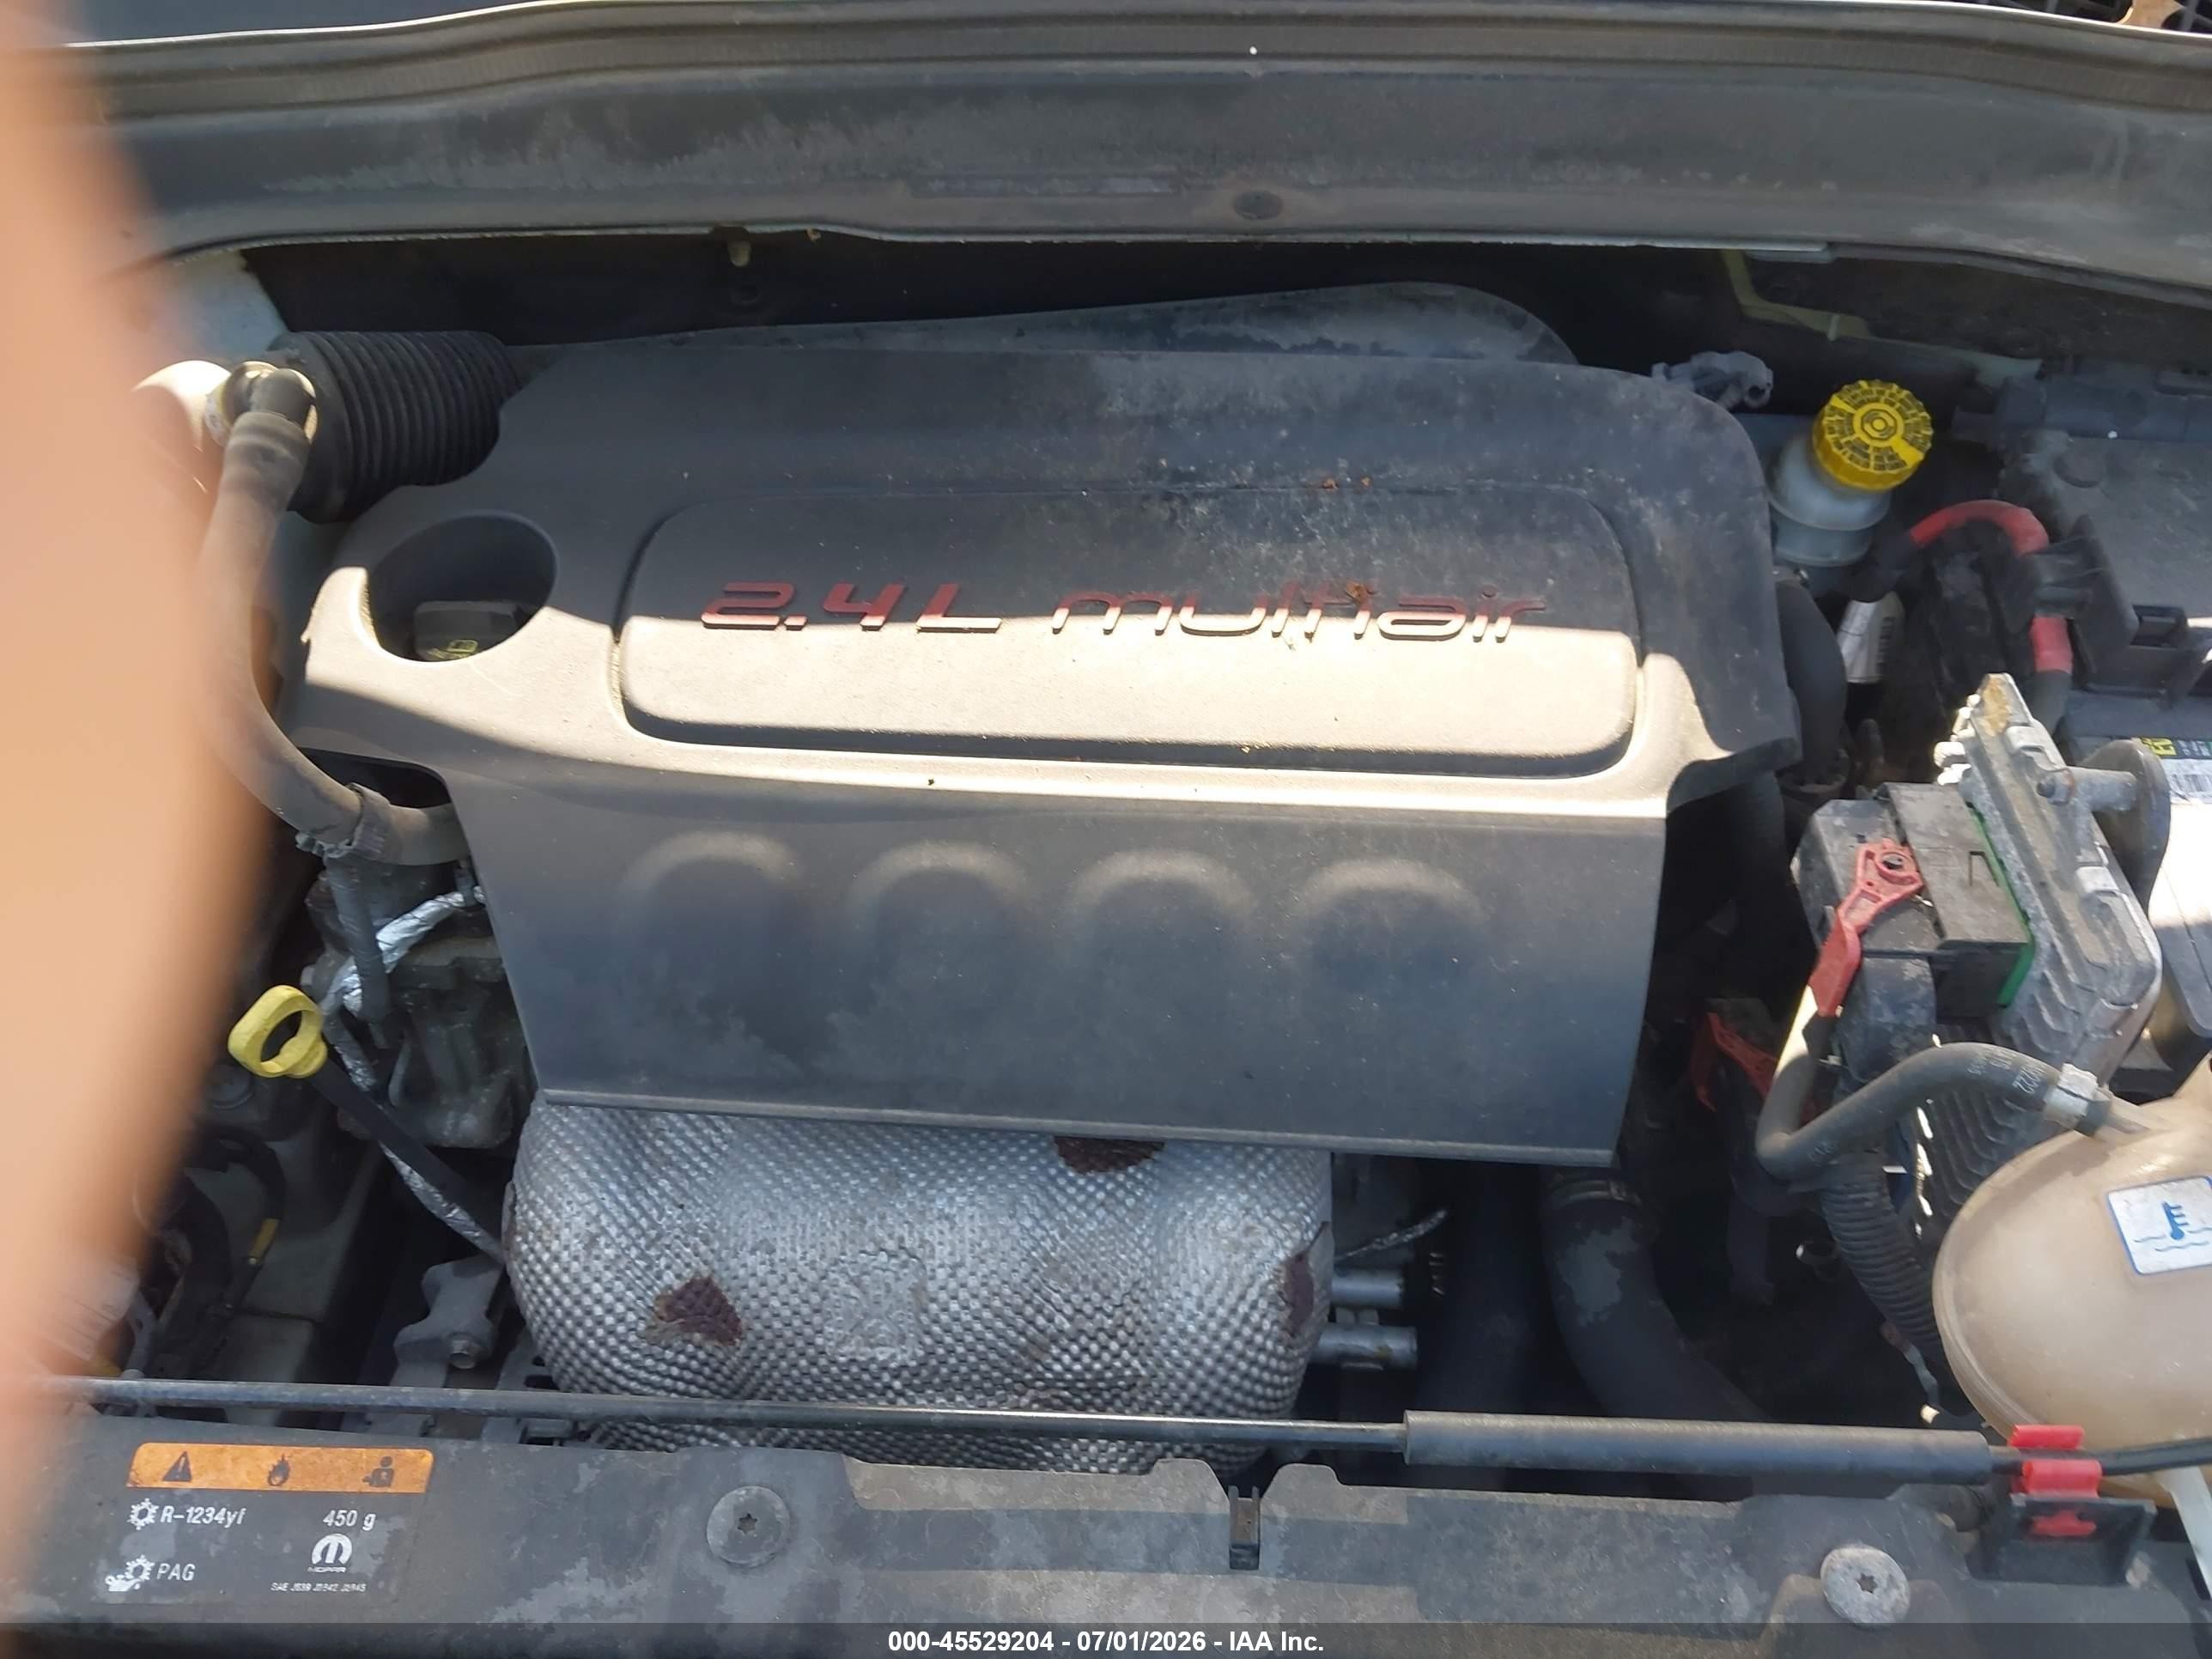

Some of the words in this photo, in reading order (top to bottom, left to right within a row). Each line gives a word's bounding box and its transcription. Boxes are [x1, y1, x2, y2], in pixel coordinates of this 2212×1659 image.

[1051, 583, 1545, 641] multiair
[160, 1505, 247, 1528] R-1234yf
[323, 1510, 358, 1527] 450
[362, 1513, 377, 1531] g
[156, 1563, 196, 1581] PAG
